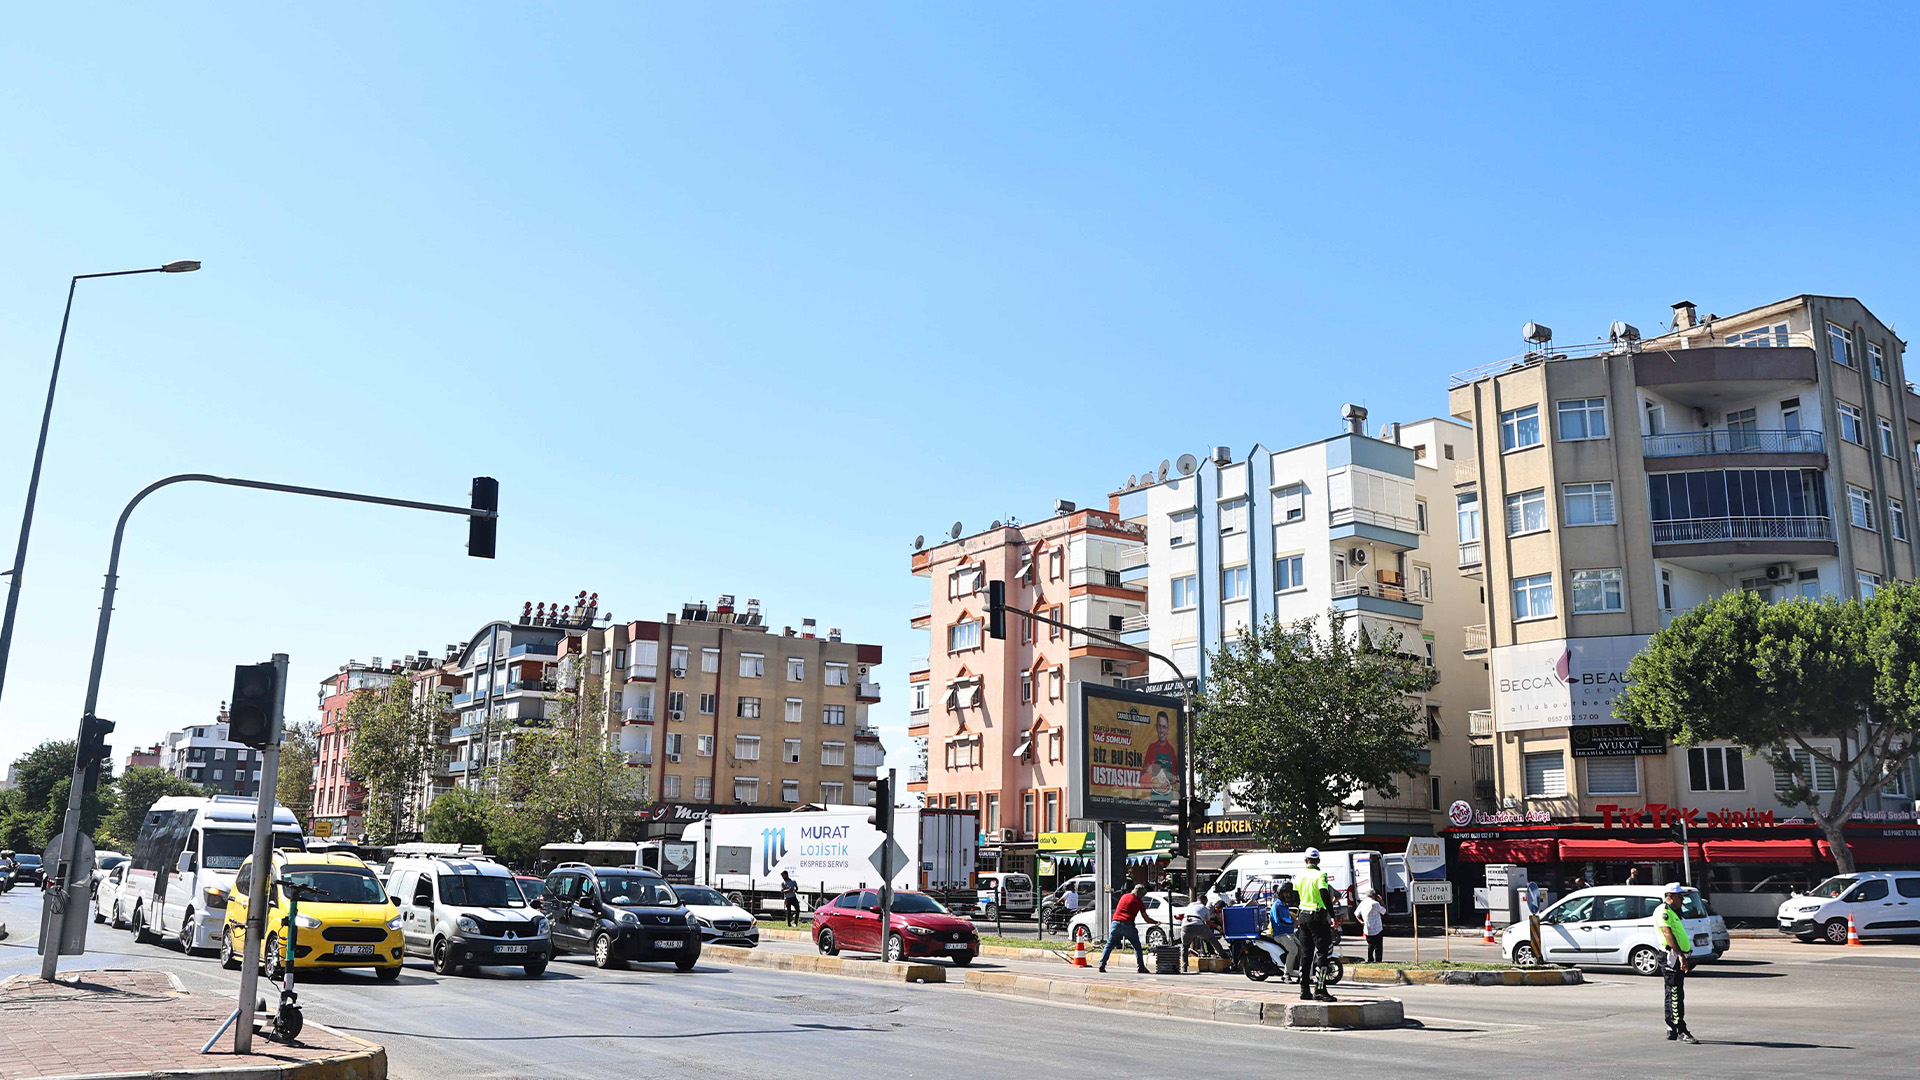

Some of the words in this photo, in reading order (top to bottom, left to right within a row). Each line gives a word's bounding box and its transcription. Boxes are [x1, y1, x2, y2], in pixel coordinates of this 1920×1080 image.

[1164, 682, 1174, 691] ALP
[1500, 677, 1553, 692] BECCA
[1582, 672, 1631, 684] BEAU
[1093, 733, 1105, 742] YAĞ
[1106, 735, 1132, 746] SOMUNU
[1598, 741, 1640, 749] AVUKAT
[1094, 746, 1107, 763] BİZ
[1111, 749, 1123, 765] BU
[1125, 748, 1143, 768] İŞİN
[1093, 766, 1141, 788] USTASIYIZ
[1475, 809, 1524, 824] İskenderun
[1706, 807, 1774, 829] DÜRÜM
[801, 825, 850, 840] MURAT
[800, 842, 849, 856] LOJİSTİK
[800, 860, 827, 868] EKSPRES
[827, 860, 849, 868] SERVİS
[1416, 885, 1449, 893] Kızılırmak
[1421, 893, 1446, 901] Caddesi
